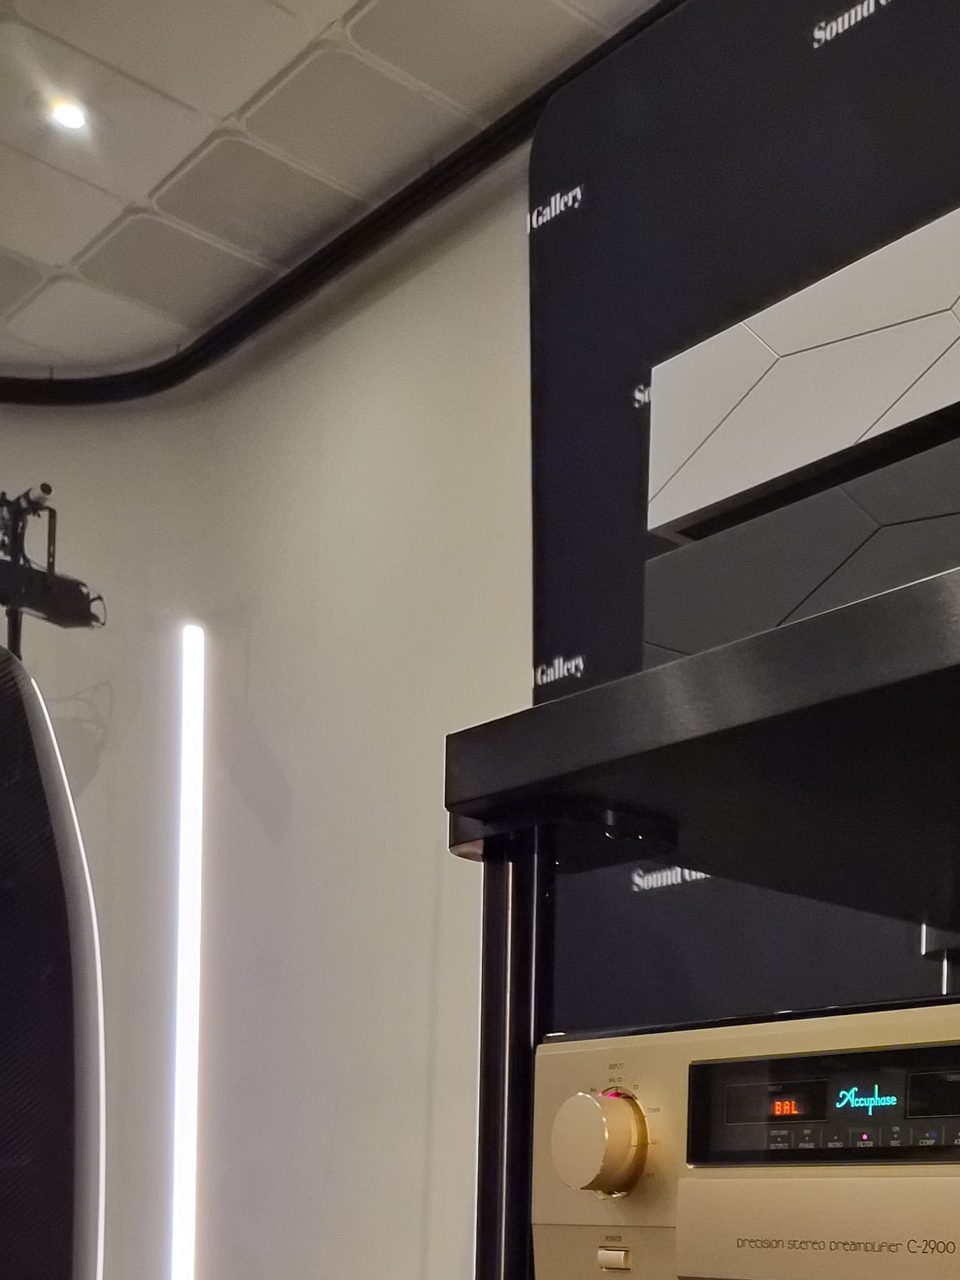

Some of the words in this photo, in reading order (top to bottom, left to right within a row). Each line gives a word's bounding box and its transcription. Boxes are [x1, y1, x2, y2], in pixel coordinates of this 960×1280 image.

[531, 184, 584, 229] Gallery
[773, 1100, 800, 1116] BAL
[835, 1084, 898, 1116] Accuphase
[787, 1239, 826, 1251] stereo
[907, 1239, 956, 1254] C-2900
